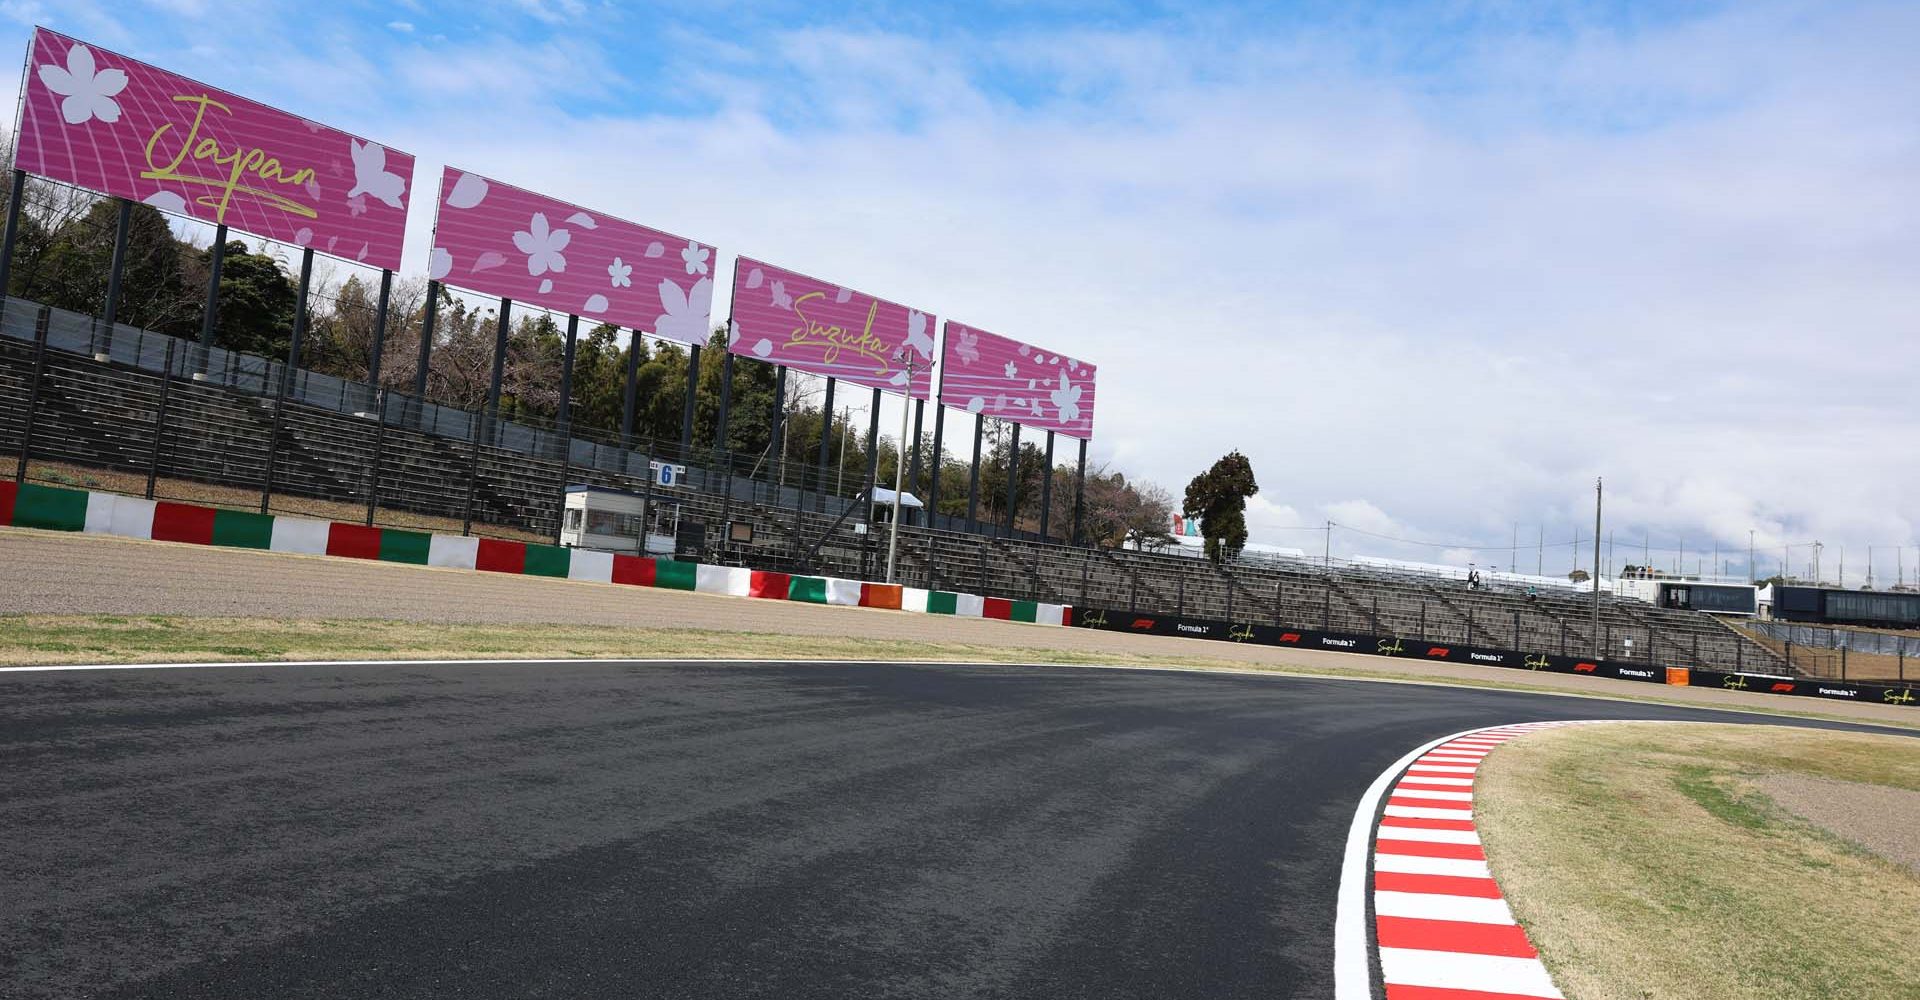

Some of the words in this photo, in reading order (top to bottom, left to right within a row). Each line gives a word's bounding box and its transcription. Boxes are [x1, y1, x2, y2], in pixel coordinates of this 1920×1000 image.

[141, 93, 317, 223] Japan
[784, 291, 890, 374] Suzuka
[661, 465, 672, 484] 6
[1178, 623, 1201, 633] Formula
[1323, 637, 1348, 647] Formula
[1471, 652, 1496, 661] Formula
[1620, 668, 1646, 677] Formula
[1819, 687, 1848, 696] Formula
